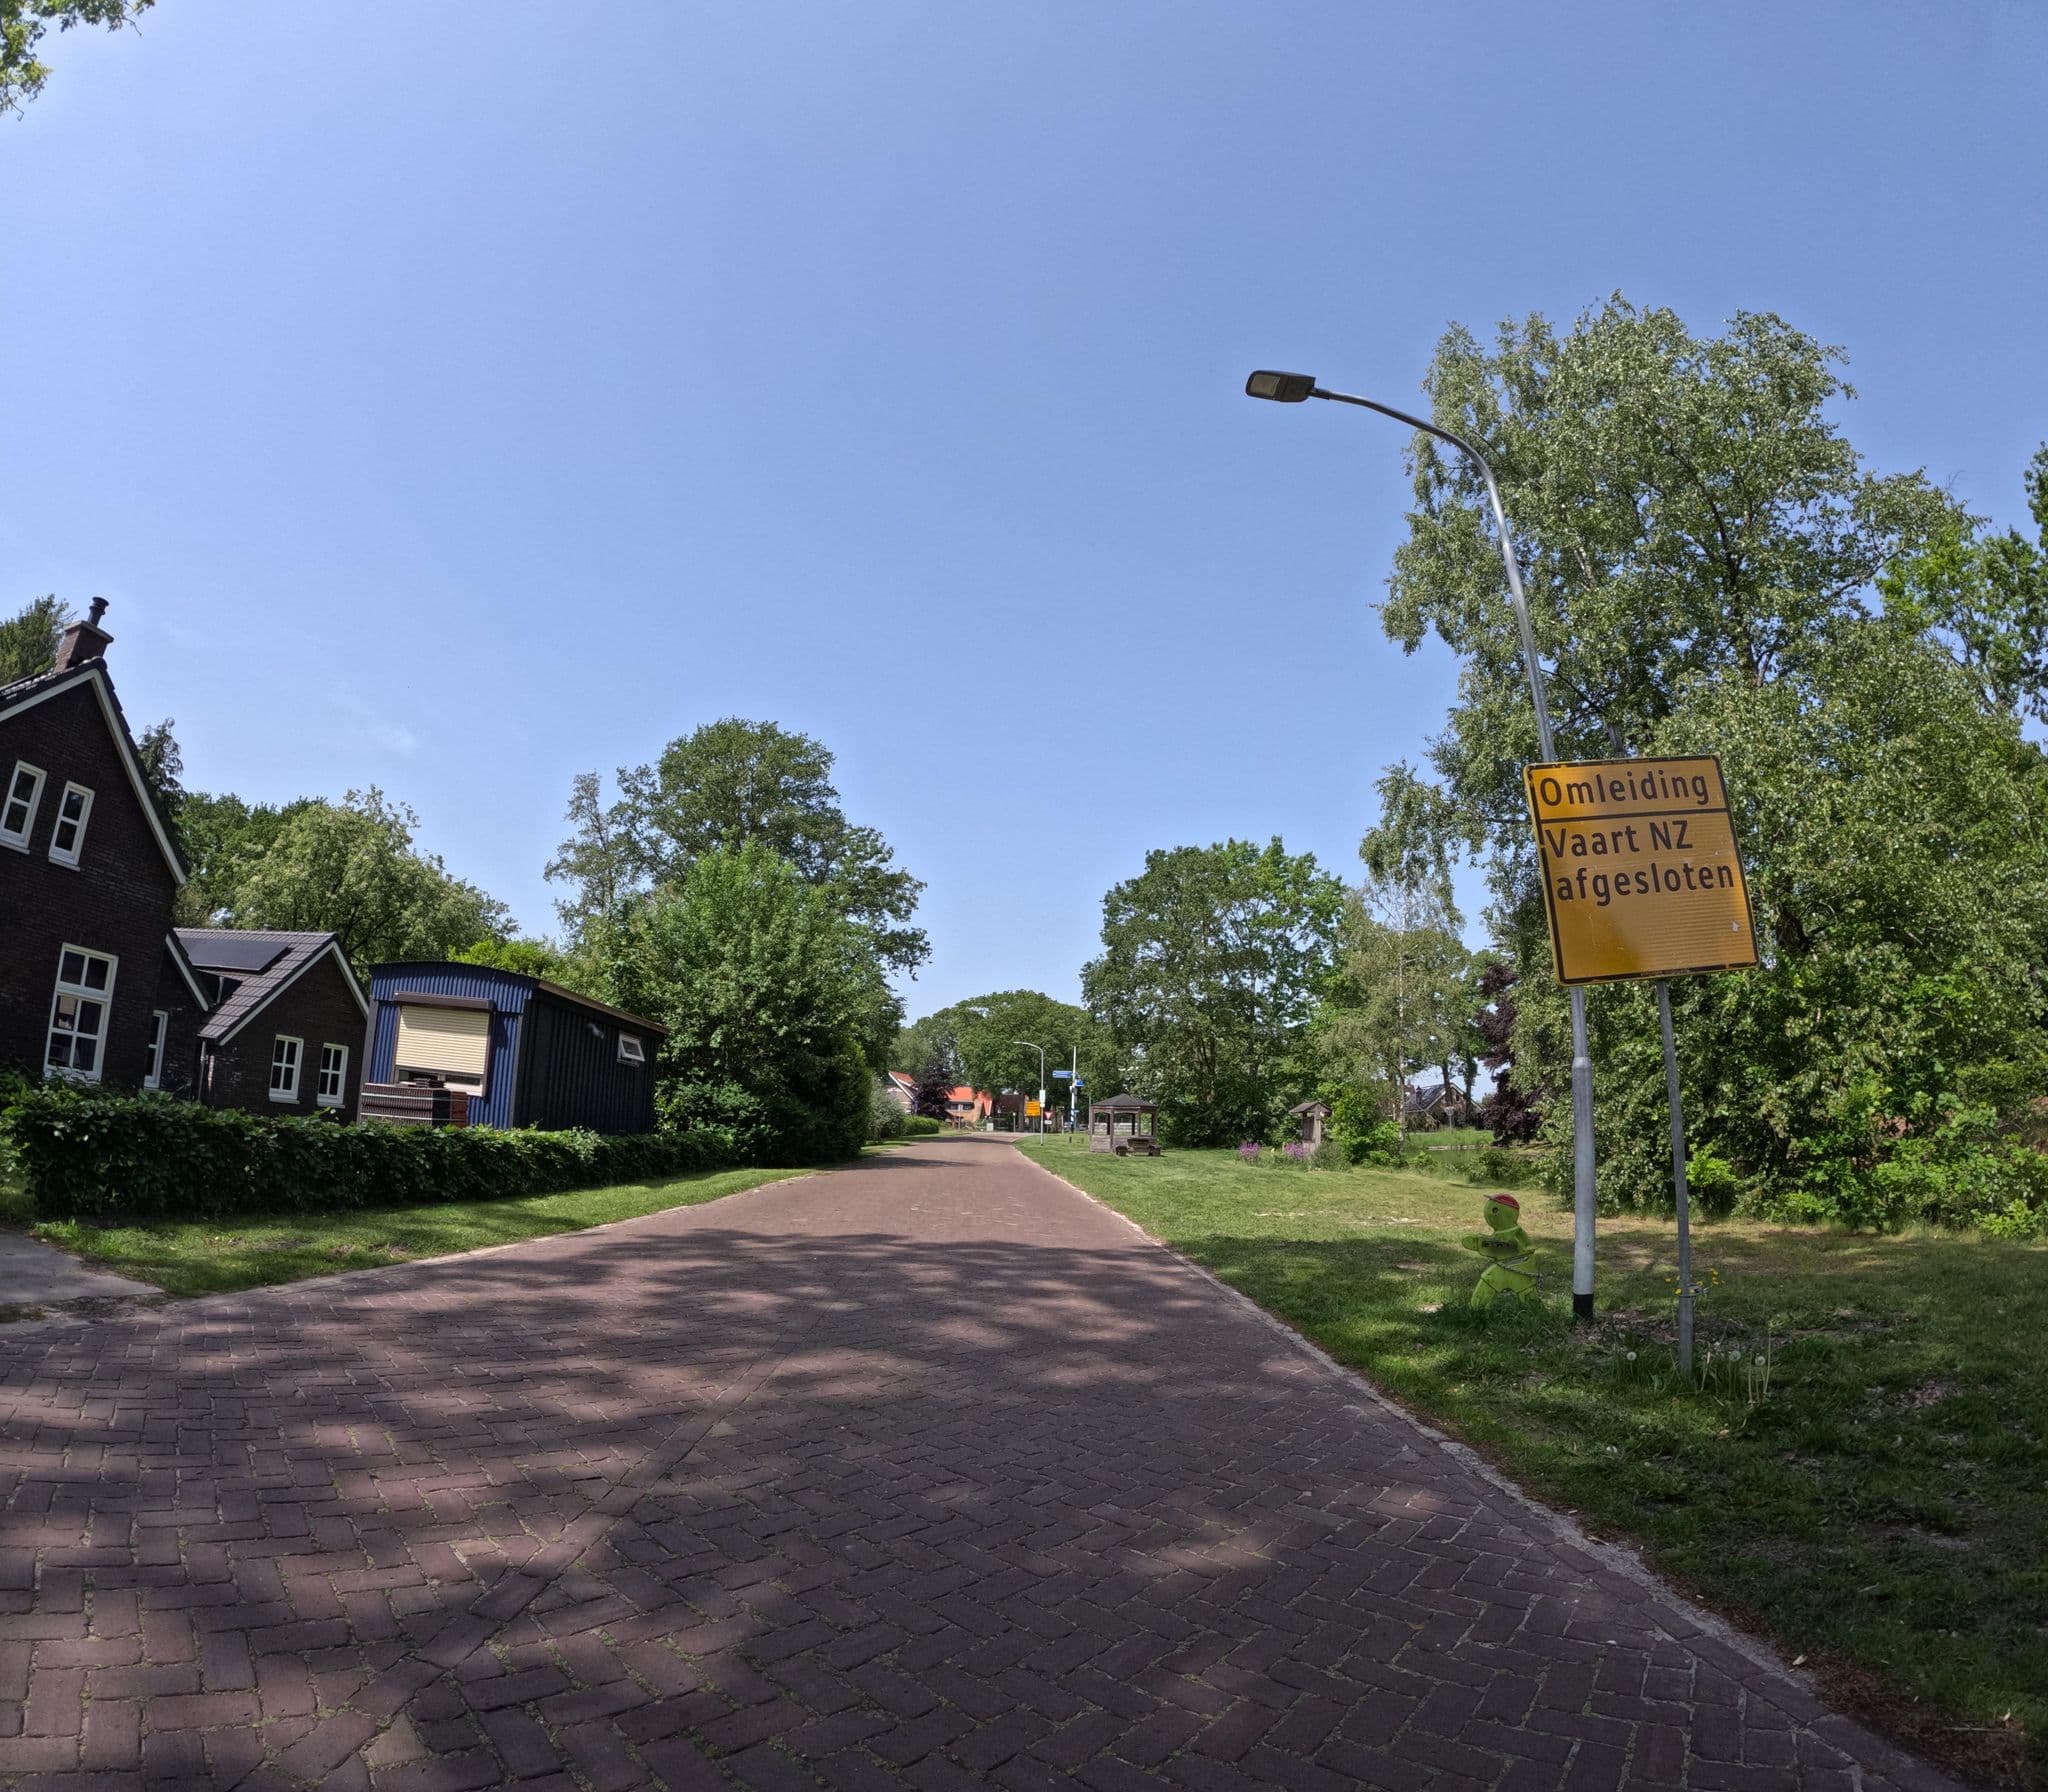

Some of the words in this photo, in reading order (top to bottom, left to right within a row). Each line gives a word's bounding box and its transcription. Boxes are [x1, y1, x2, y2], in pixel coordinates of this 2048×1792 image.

[1540, 770, 1709, 806] Omleiding
[1545, 825, 1640, 858] Vaart
[1649, 820, 1693, 851] NZ
[1557, 862, 1734, 906] afgesloten
